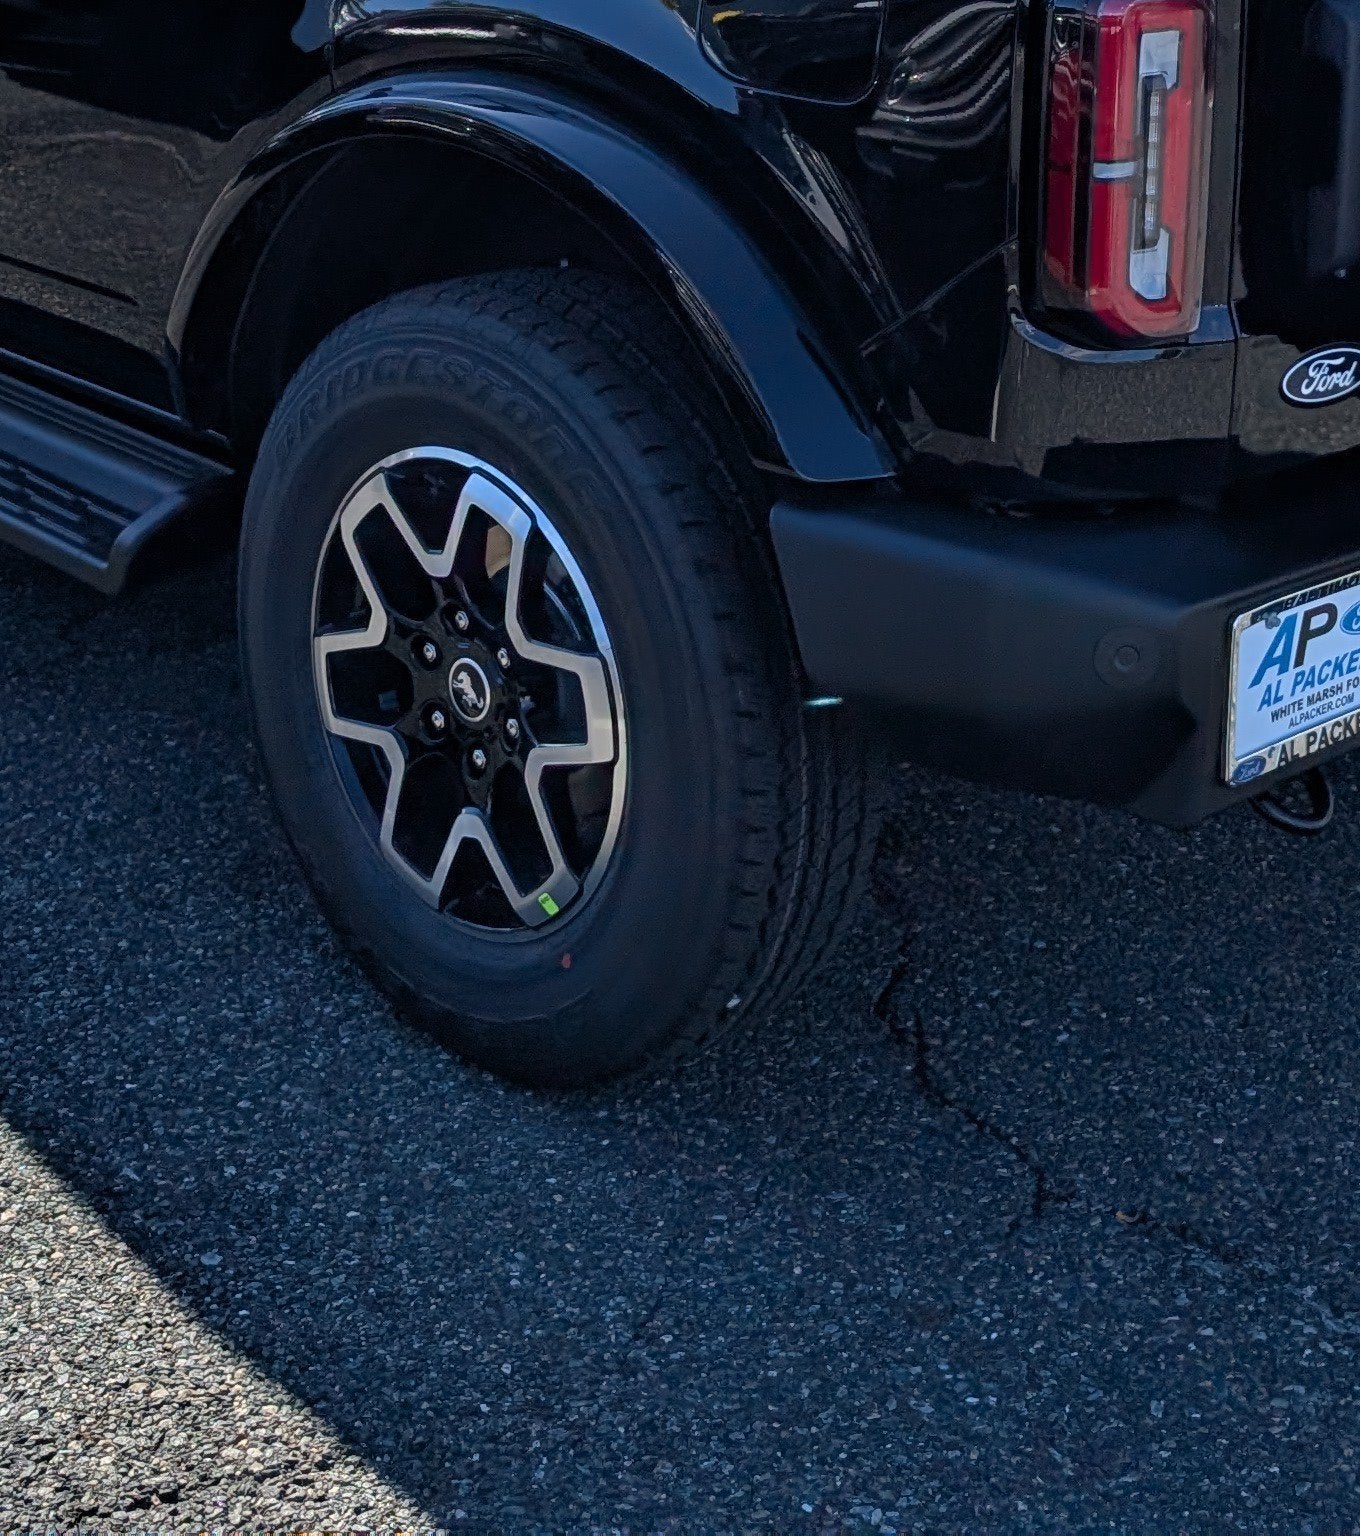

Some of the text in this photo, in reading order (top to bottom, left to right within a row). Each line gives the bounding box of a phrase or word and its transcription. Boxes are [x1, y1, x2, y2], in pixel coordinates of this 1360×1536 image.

[1300, 356, 1359, 396] Ford
[1247, 602, 1339, 690] AP
[1256, 678, 1285, 713] AL
[1270, 698, 1304, 723] WHITE
[1306, 681, 1344, 708] MARSH
[1288, 691, 1355, 730] ALPACKER.COM
[1278, 739, 1300, 767] AL
